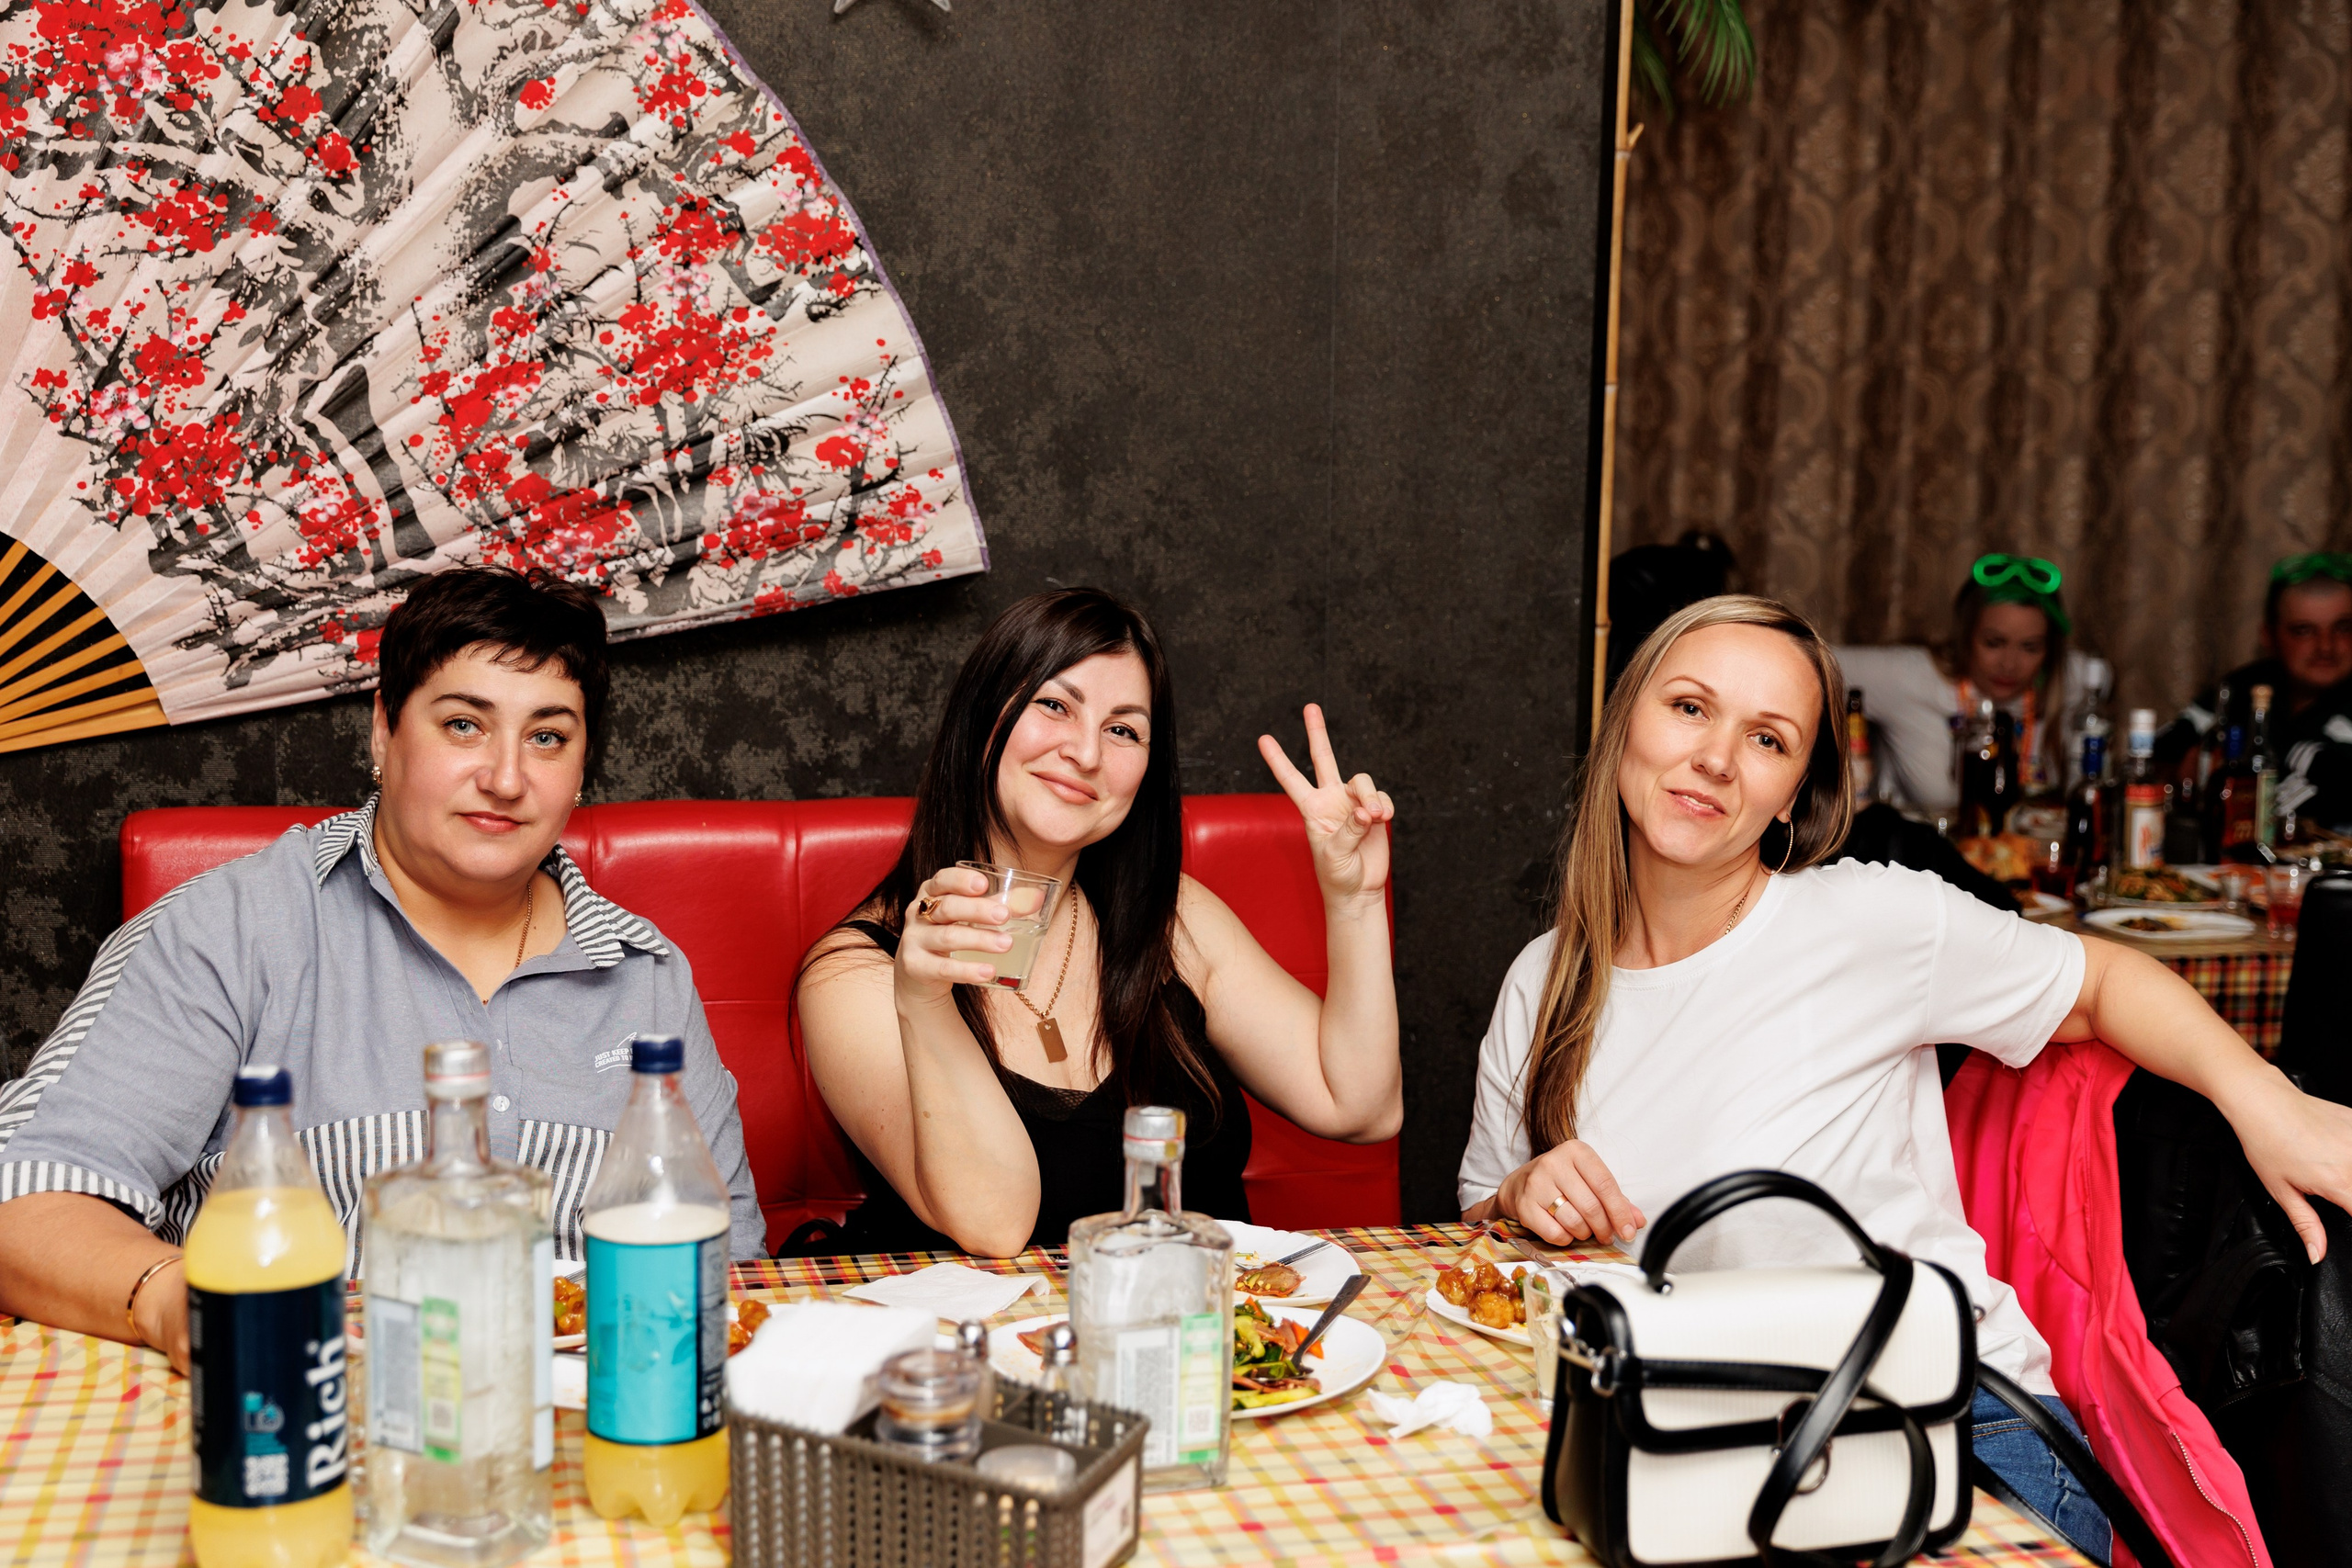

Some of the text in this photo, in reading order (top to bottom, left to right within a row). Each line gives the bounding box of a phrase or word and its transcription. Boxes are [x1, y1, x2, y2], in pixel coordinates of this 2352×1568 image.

[594, 1051, 610, 1063] JUST
[612, 1048, 629, 1056] KEEP
[594, 1055, 620, 1067] CREATED
[305, 1333, 347, 1488] Rich
